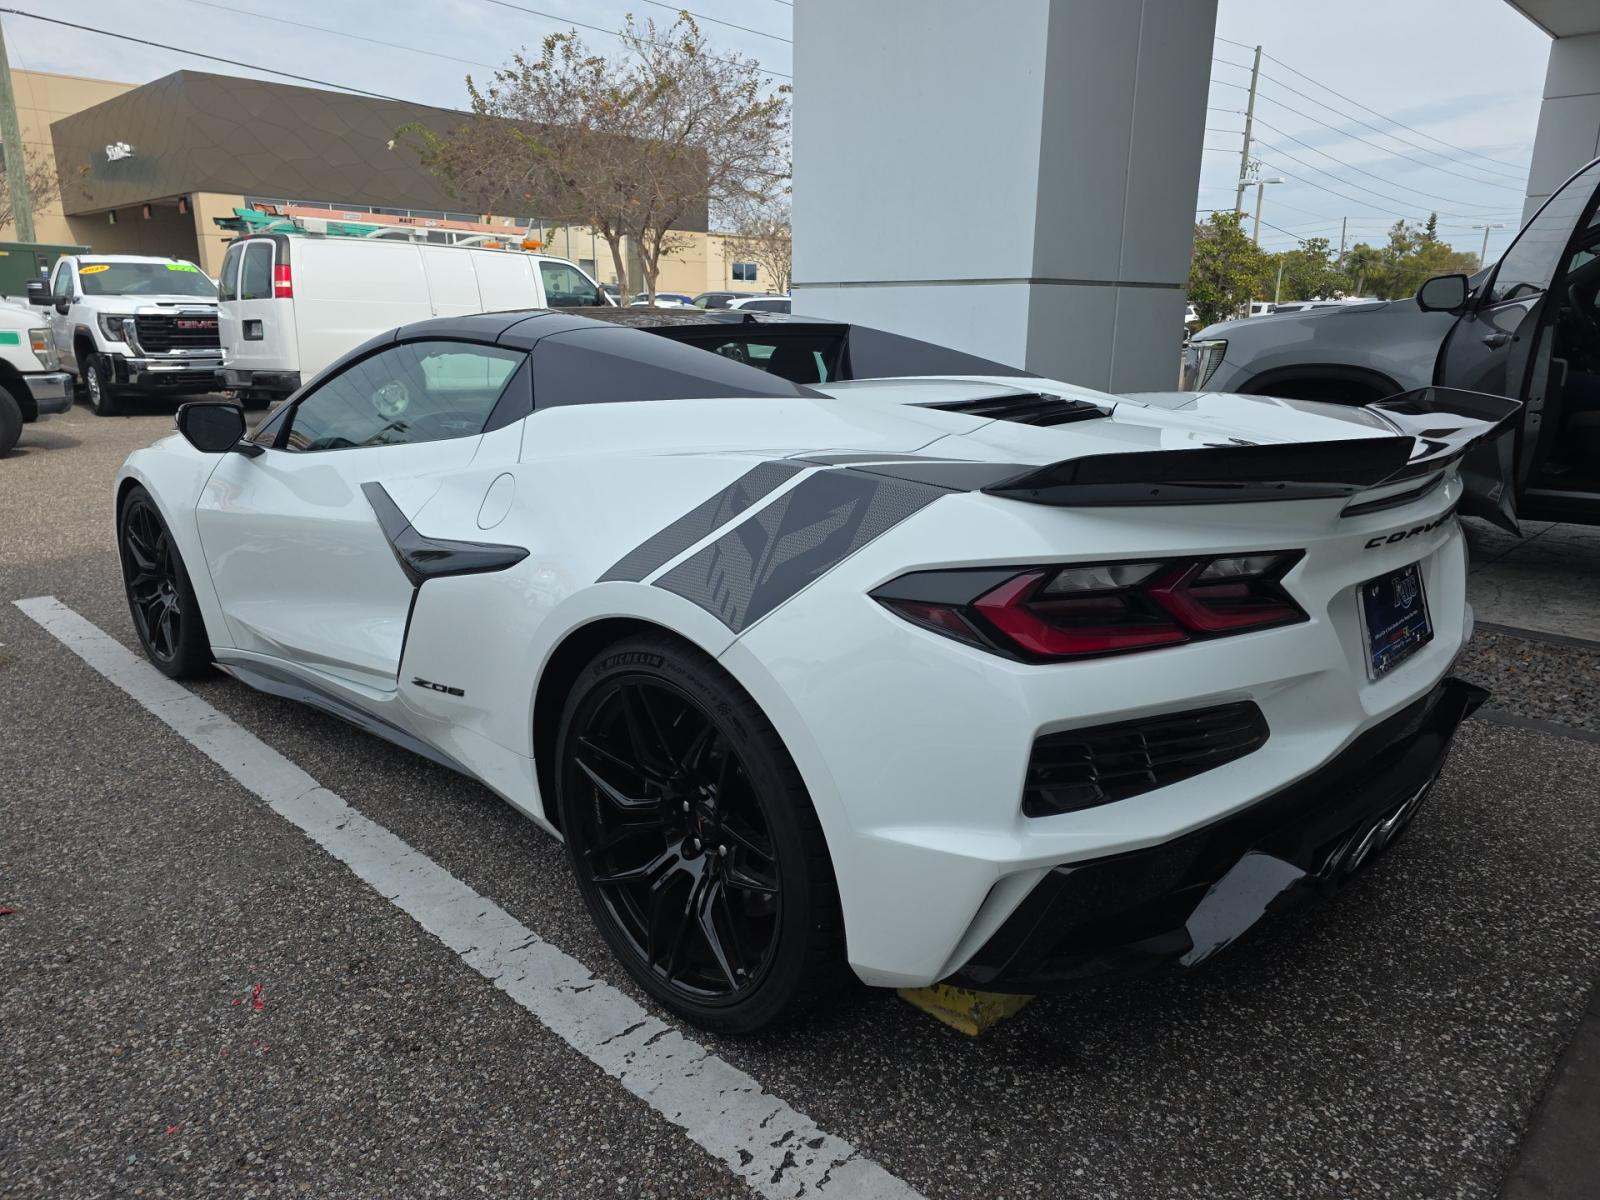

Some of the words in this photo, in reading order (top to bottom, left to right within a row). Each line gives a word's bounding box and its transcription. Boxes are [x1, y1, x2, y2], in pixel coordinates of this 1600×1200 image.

[177, 320, 218, 329] GMC
[605, 652, 662, 667] MICHELIN
[411, 676, 465, 697] Z06
